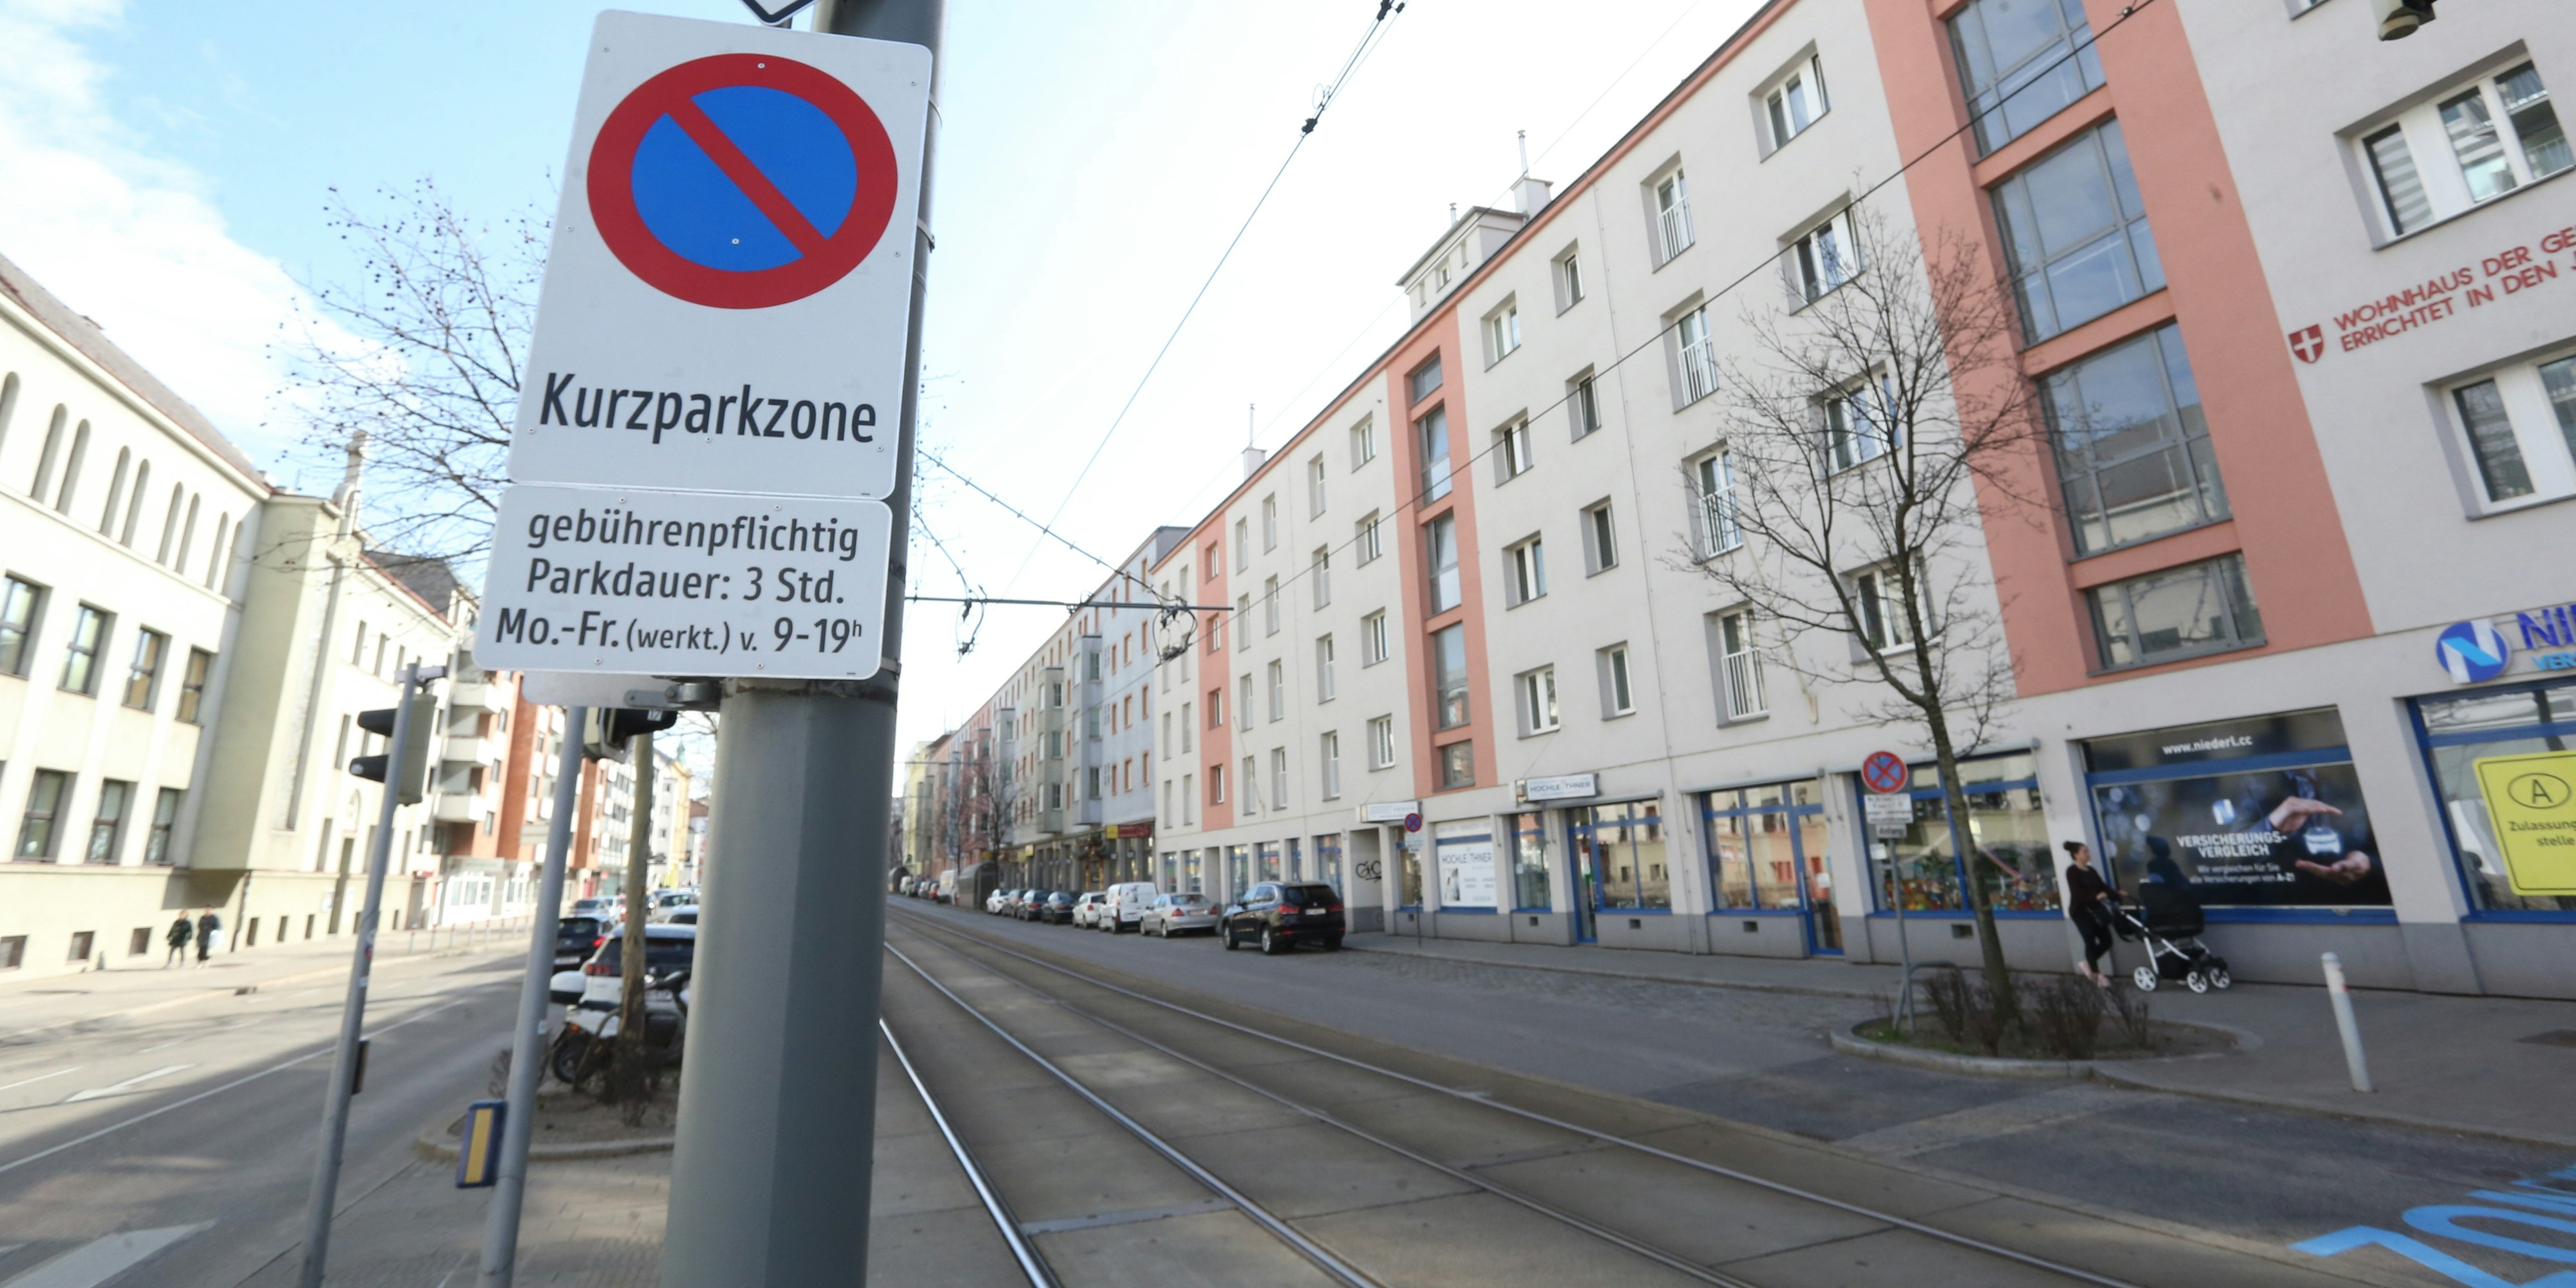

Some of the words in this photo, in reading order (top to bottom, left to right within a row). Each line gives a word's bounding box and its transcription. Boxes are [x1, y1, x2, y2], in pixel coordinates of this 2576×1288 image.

[2333, 267, 2474, 331] WOHNHAUS
[2481, 245, 2533, 278] DER
[2540, 225, 2576, 254] GE
[2340, 296, 2453, 352] ERRICHTET
[2466, 284, 2494, 307] IN
[2501, 260, 2557, 294] DEN
[540, 372, 876, 444] Kurzparkzone
[527, 508, 858, 561] gebührenpflichtig
[527, 558, 730, 600] Parkdauer:
[743, 567, 762, 601] 3
[775, 567, 844, 603] Std.
[740, 631, 757, 652] v.
[2530, 651, 2576, 672] VER
[2162, 735, 2253, 755] www.niederl.cc
[2532, 779, 2553, 804] A
[2176, 831, 2288, 848] VERSICHERUNGS-
[2197, 843, 2271, 858] VERGLEICH
[2536, 835, 2575, 847] stelle
